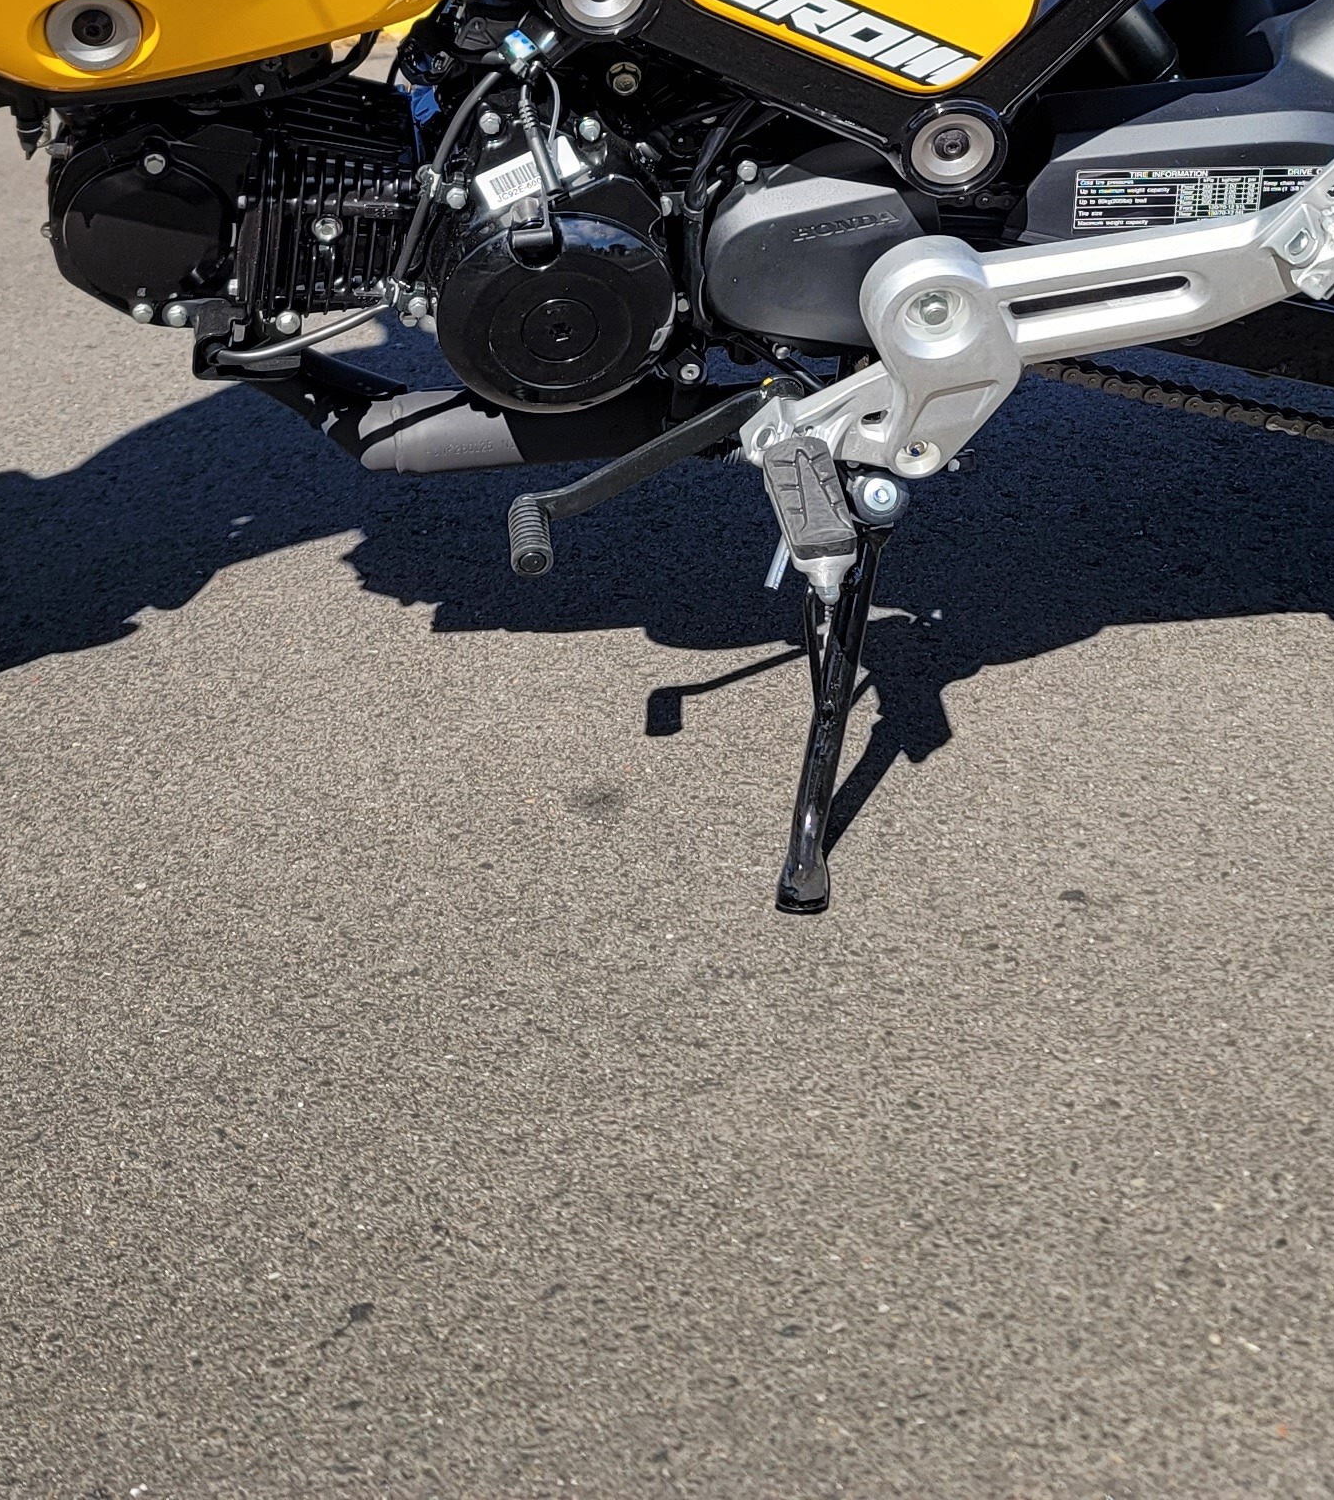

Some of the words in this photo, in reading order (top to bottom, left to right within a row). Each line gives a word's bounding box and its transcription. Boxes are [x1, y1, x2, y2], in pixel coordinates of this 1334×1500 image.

[1129, 170, 1148, 178] TIRE
[1152, 170, 1208, 178] INFORMATION
[791, 211, 900, 242] HONDA
